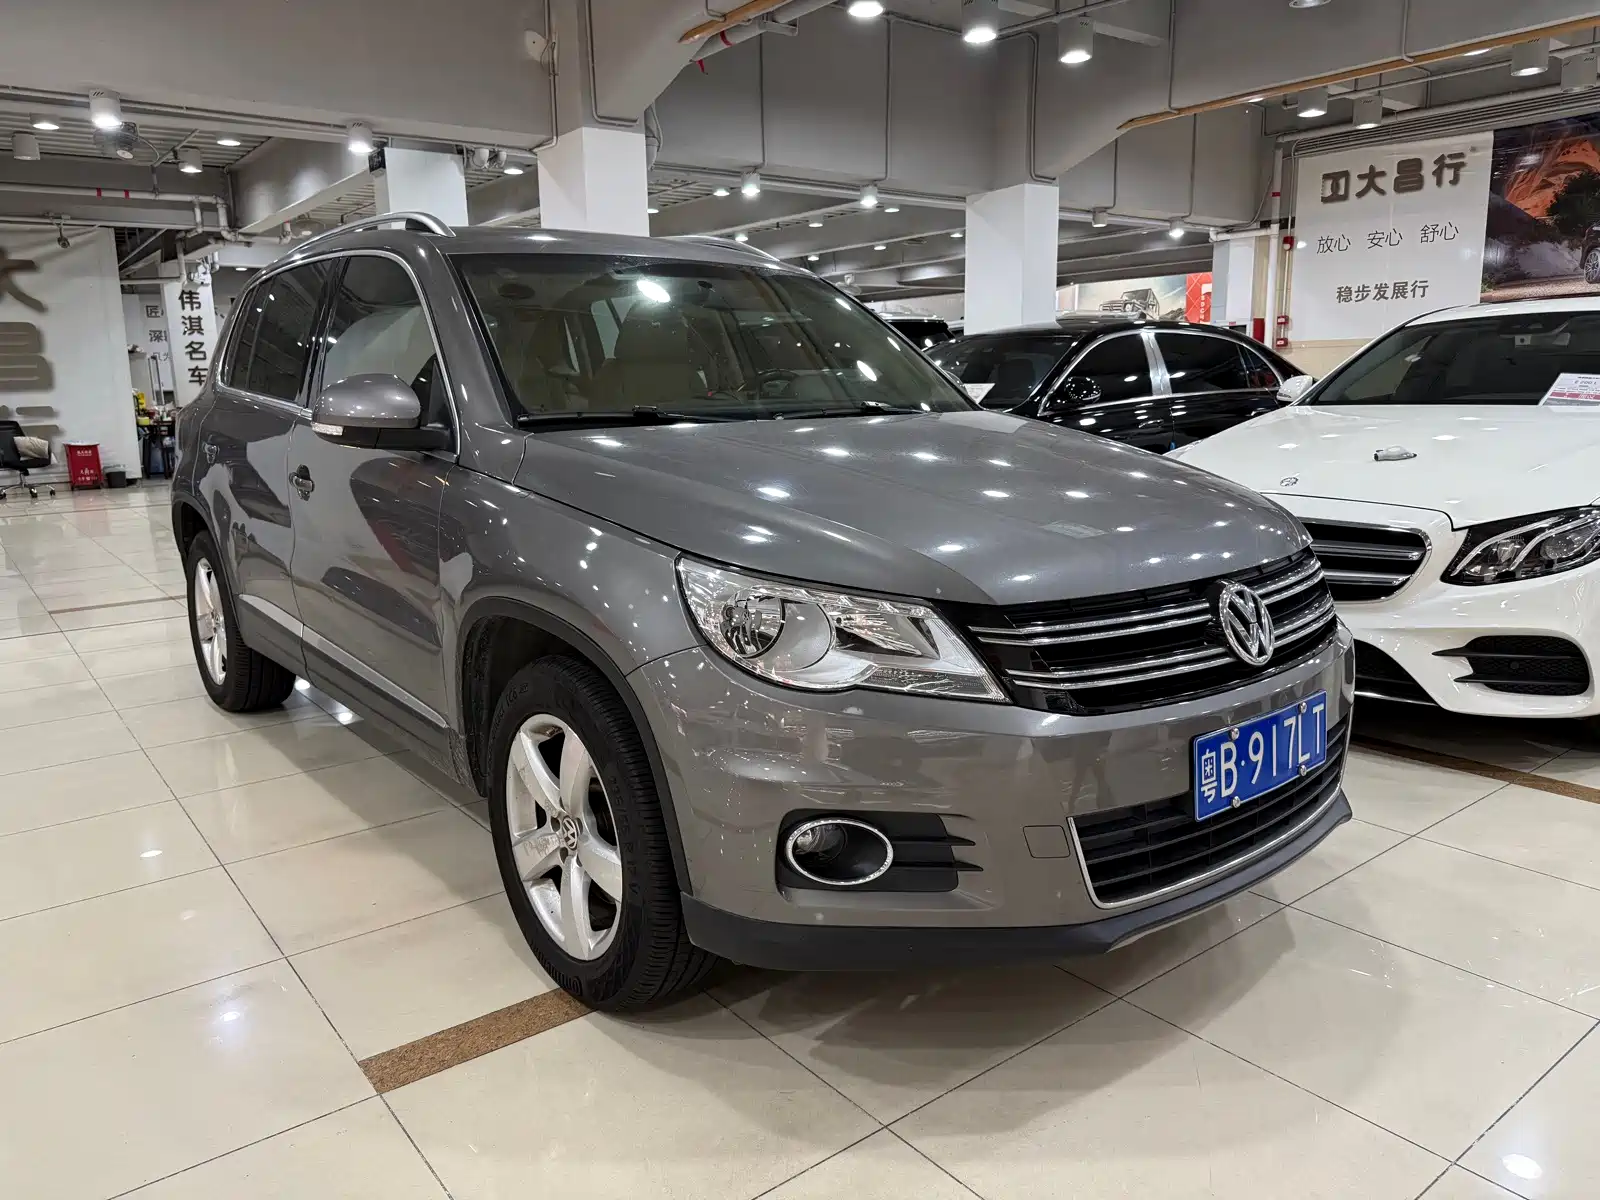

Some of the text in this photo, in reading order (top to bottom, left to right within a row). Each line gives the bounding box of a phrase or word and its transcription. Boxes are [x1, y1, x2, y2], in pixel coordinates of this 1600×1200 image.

[1355, 152, 1467, 198] 大昌行
[1317, 222, 1459, 254] 放心 安心 舒心
[1336, 280, 1429, 303] 稳步发展行
[178, 289, 208, 386] 伟淇名车
